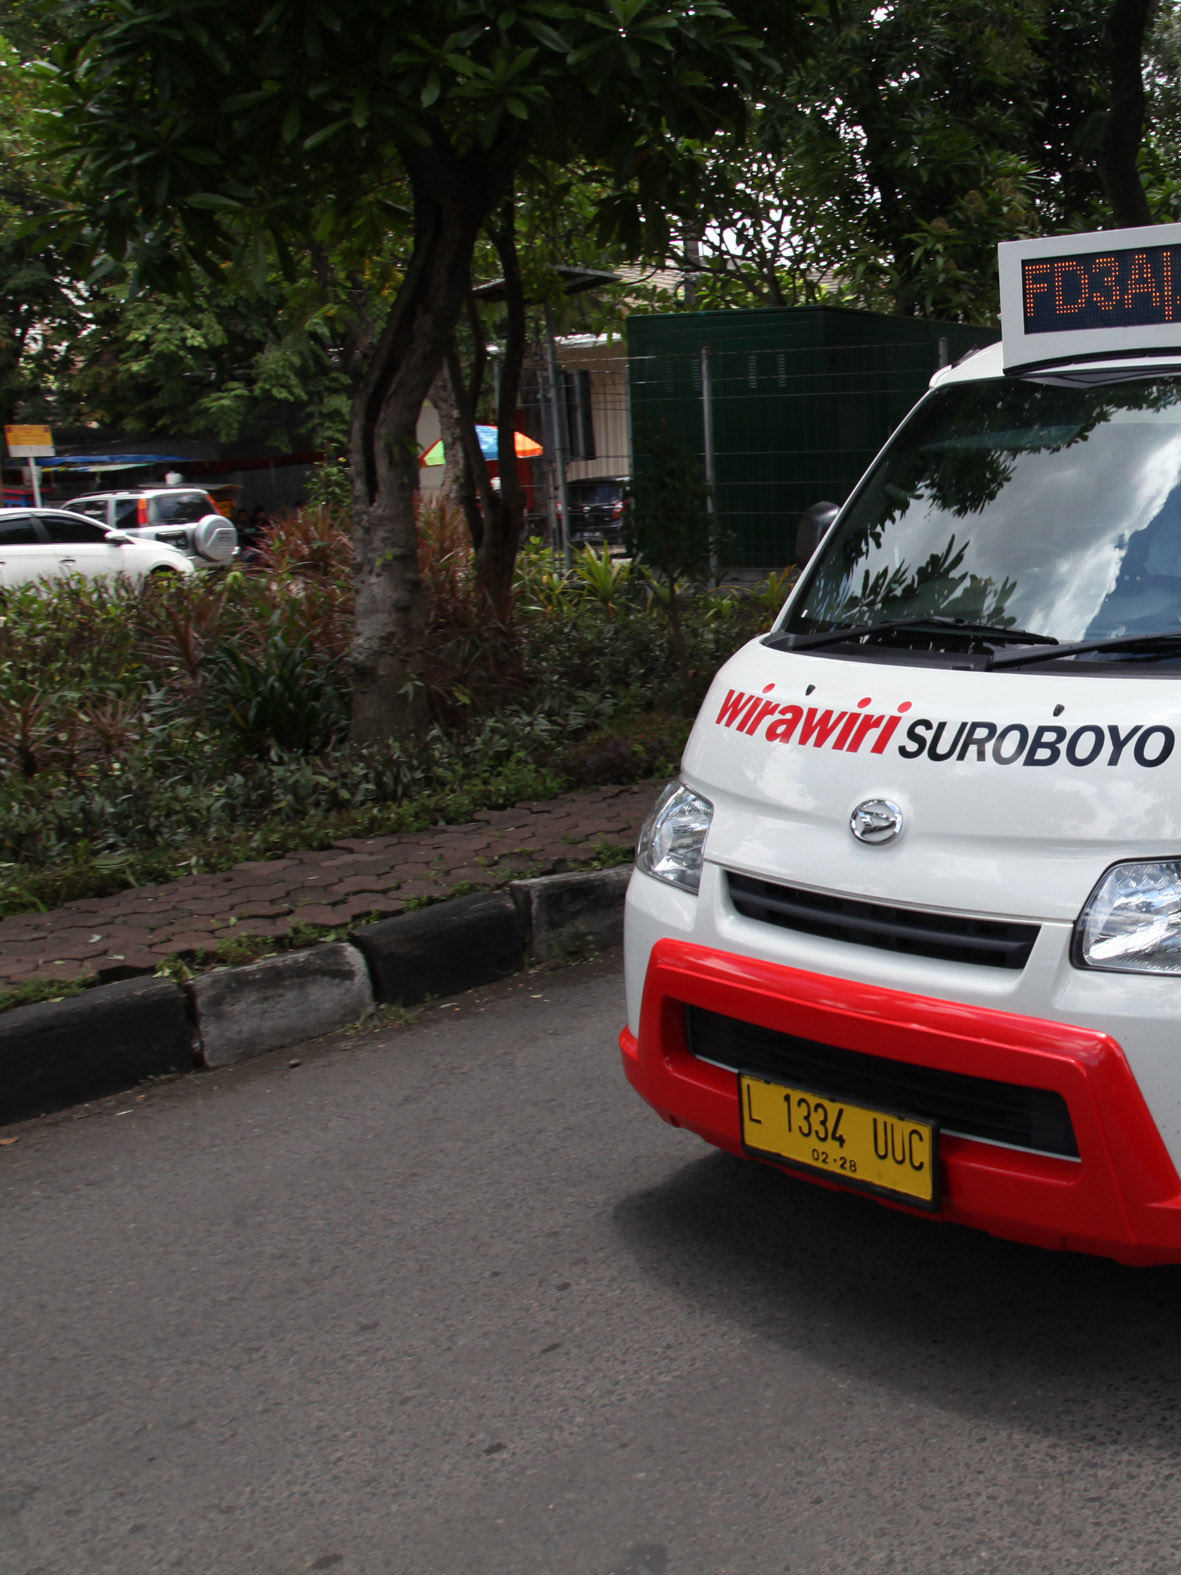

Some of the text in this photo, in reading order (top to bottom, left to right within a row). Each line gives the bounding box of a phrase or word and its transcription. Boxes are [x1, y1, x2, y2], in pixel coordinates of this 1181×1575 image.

[715, 682, 1176, 768] wirawiri SUROBOYO
[746, 1083, 925, 1171] L 1334 UUC
